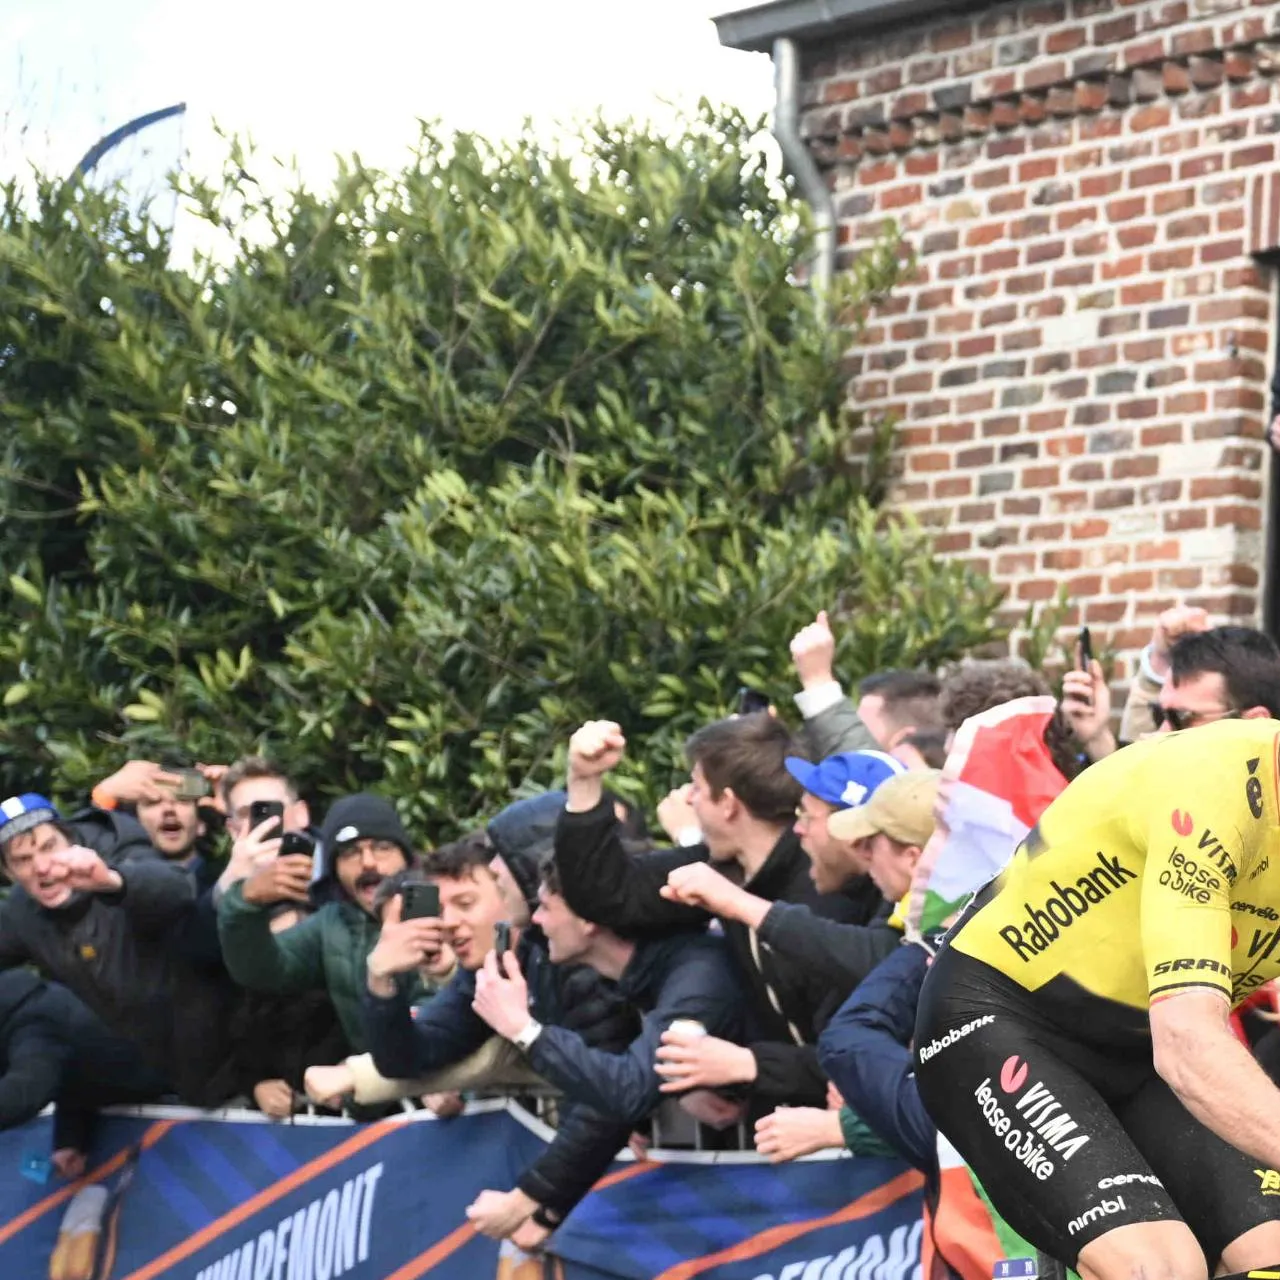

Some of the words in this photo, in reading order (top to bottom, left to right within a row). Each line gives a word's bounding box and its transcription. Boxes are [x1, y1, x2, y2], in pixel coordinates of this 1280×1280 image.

[1168, 846, 1221, 890] lease
[998, 851, 1138, 963] Rabobank
[919, 1014, 996, 1064] Rabobank
[1015, 1081, 1090, 1162] VISMA
[1097, 1173, 1165, 1190] cerv
[1067, 1195, 1126, 1236] nimbl
